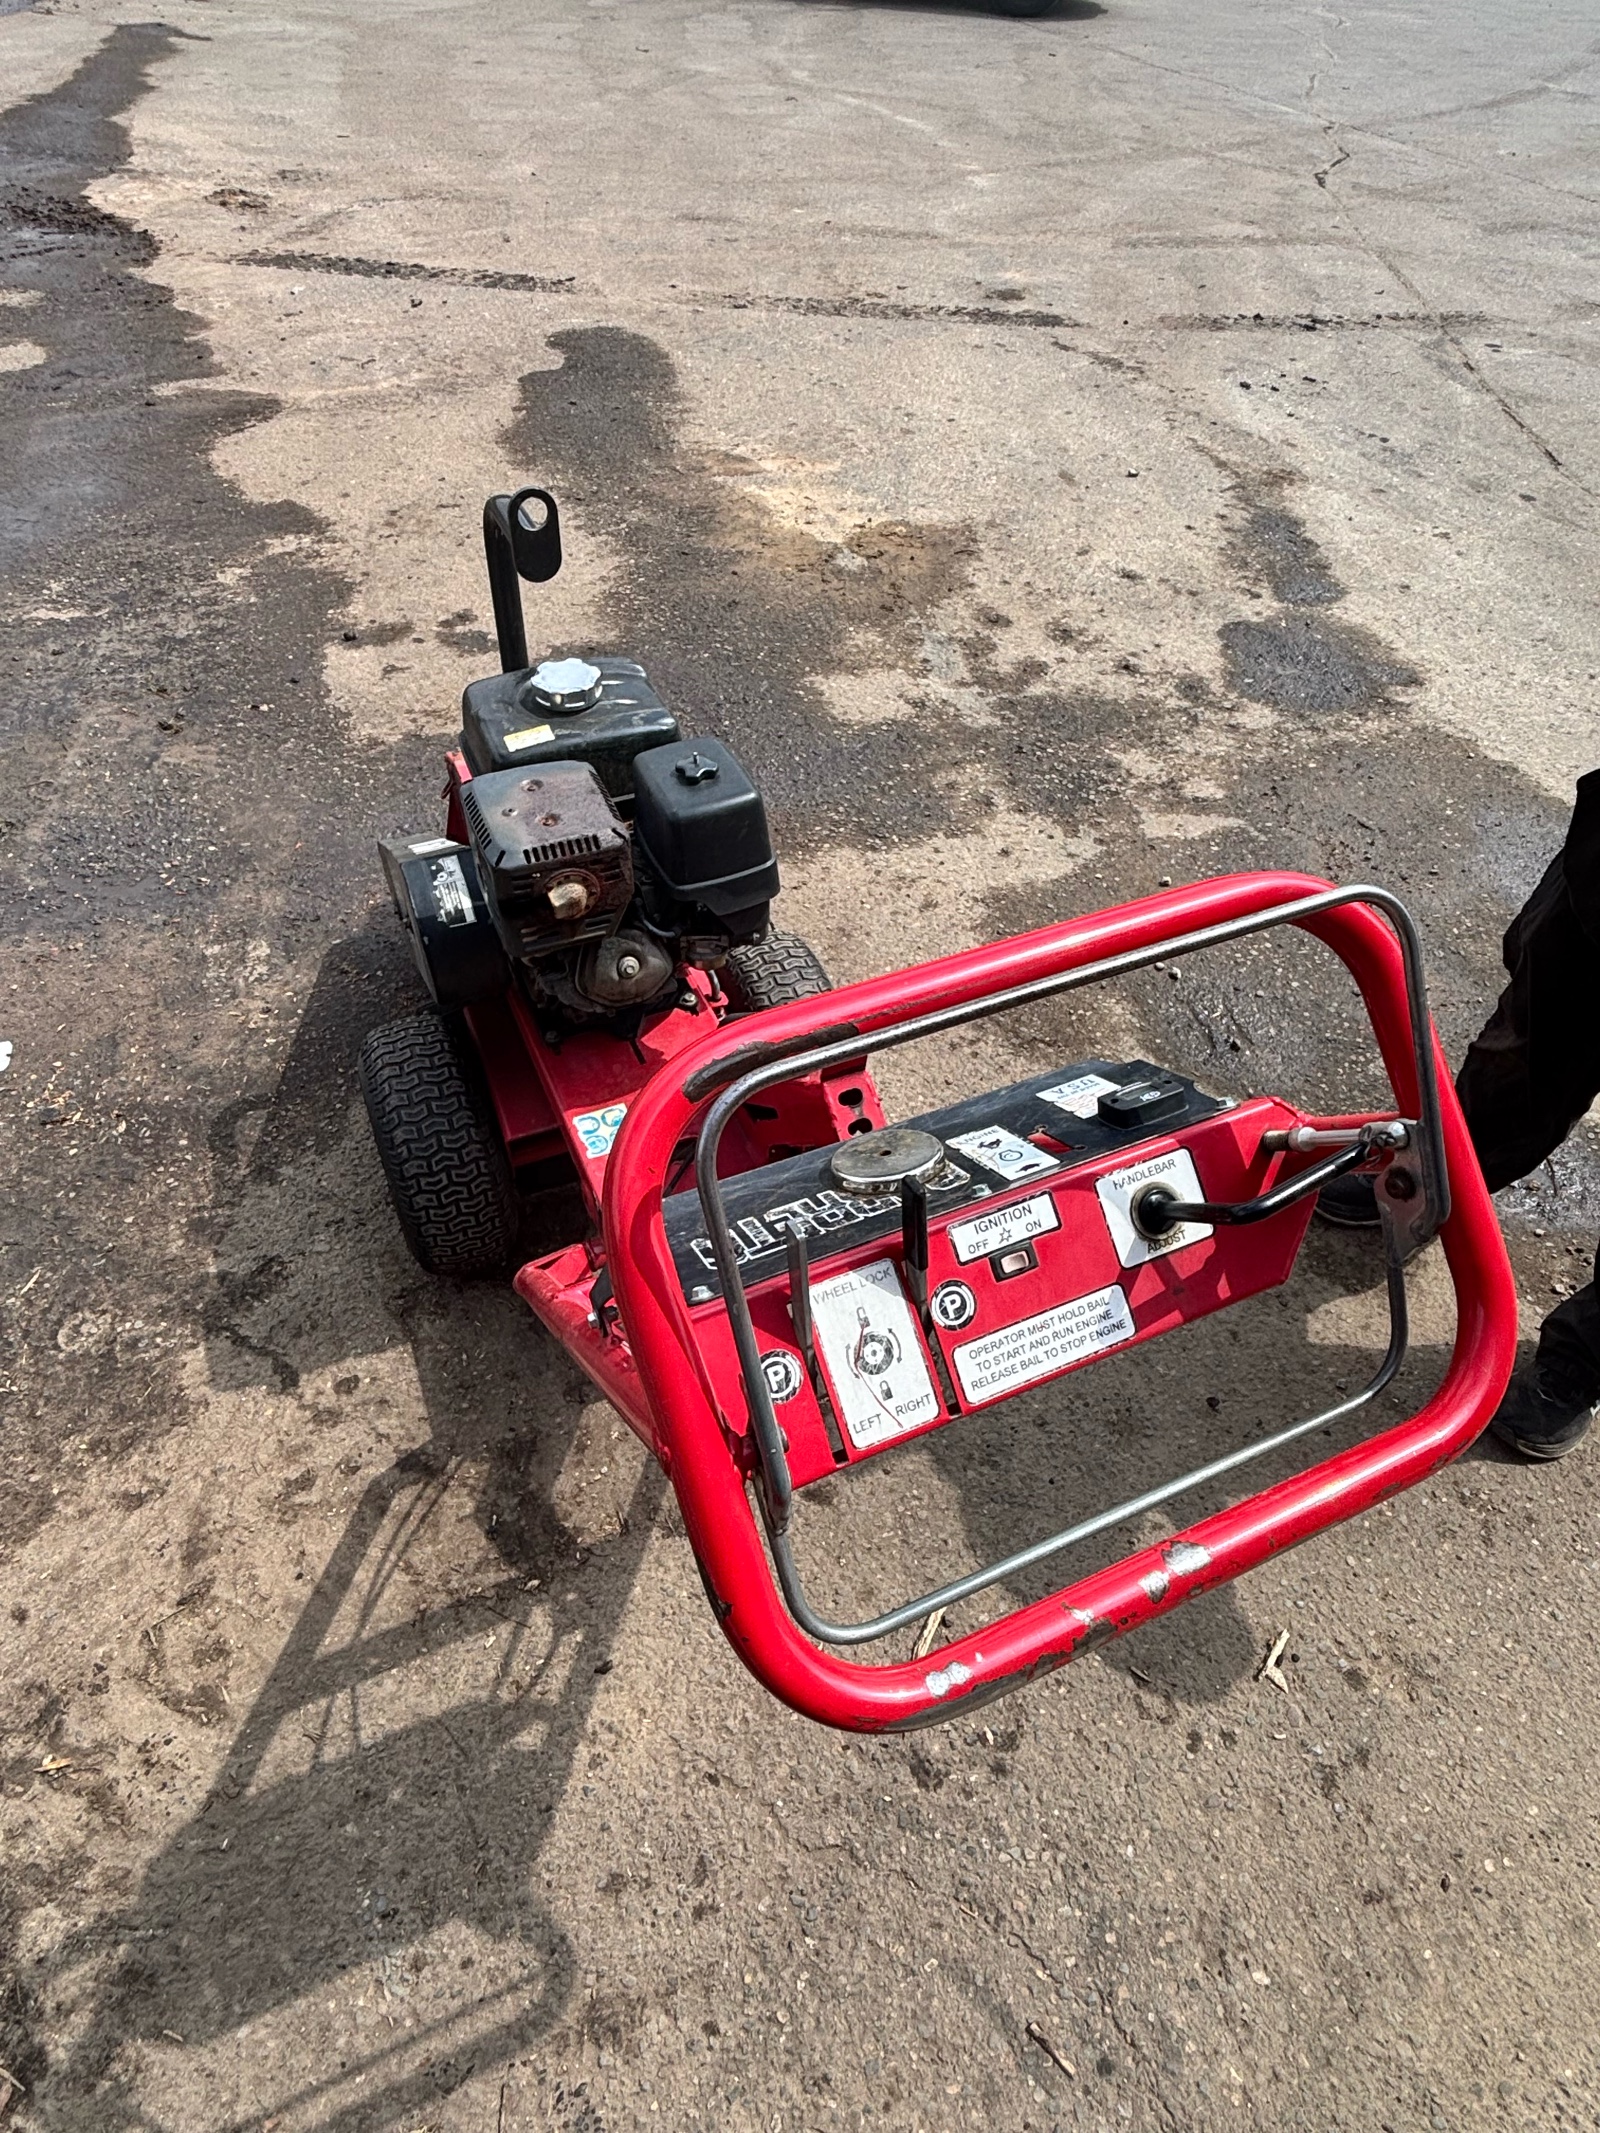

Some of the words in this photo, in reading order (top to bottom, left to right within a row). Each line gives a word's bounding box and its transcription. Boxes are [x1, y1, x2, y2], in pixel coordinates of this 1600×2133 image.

[1112, 1158, 1177, 1191] HANDLEBAR
[968, 1238, 989, 1255] OFF
[1025, 1218, 1042, 1233] ON
[973, 1203, 1033, 1235] IGNITION
[1146, 1229, 1186, 1255] ADJUST
[812, 1281, 858, 1305] WHEEL
[860, 1266, 893, 1288] LOCK
[968, 1329, 1027, 1360] OPERATOR
[1027, 1316, 1055, 1337] MUST
[1057, 1306, 1086, 1324] HOLD
[1087, 1295, 1111, 1312] BAIL
[975, 1359, 991, 1373] TO
[994, 1344, 1027, 1366] START
[1029, 1334, 1051, 1353] AND
[1052, 1326, 1075, 1343] RUN
[1075, 1308, 1115, 1335] ENGINE
[970, 1363, 1019, 1391] RELEASE
[1020, 1356, 1044, 1371] BAIL
[1043, 1347, 1059, 1361] TO
[1060, 1334, 1088, 1355] STOP
[1090, 1318, 1128, 1341] ENGINE
[852, 1412, 883, 1435] LEFT
[894, 1393, 932, 1417] RIGHT
